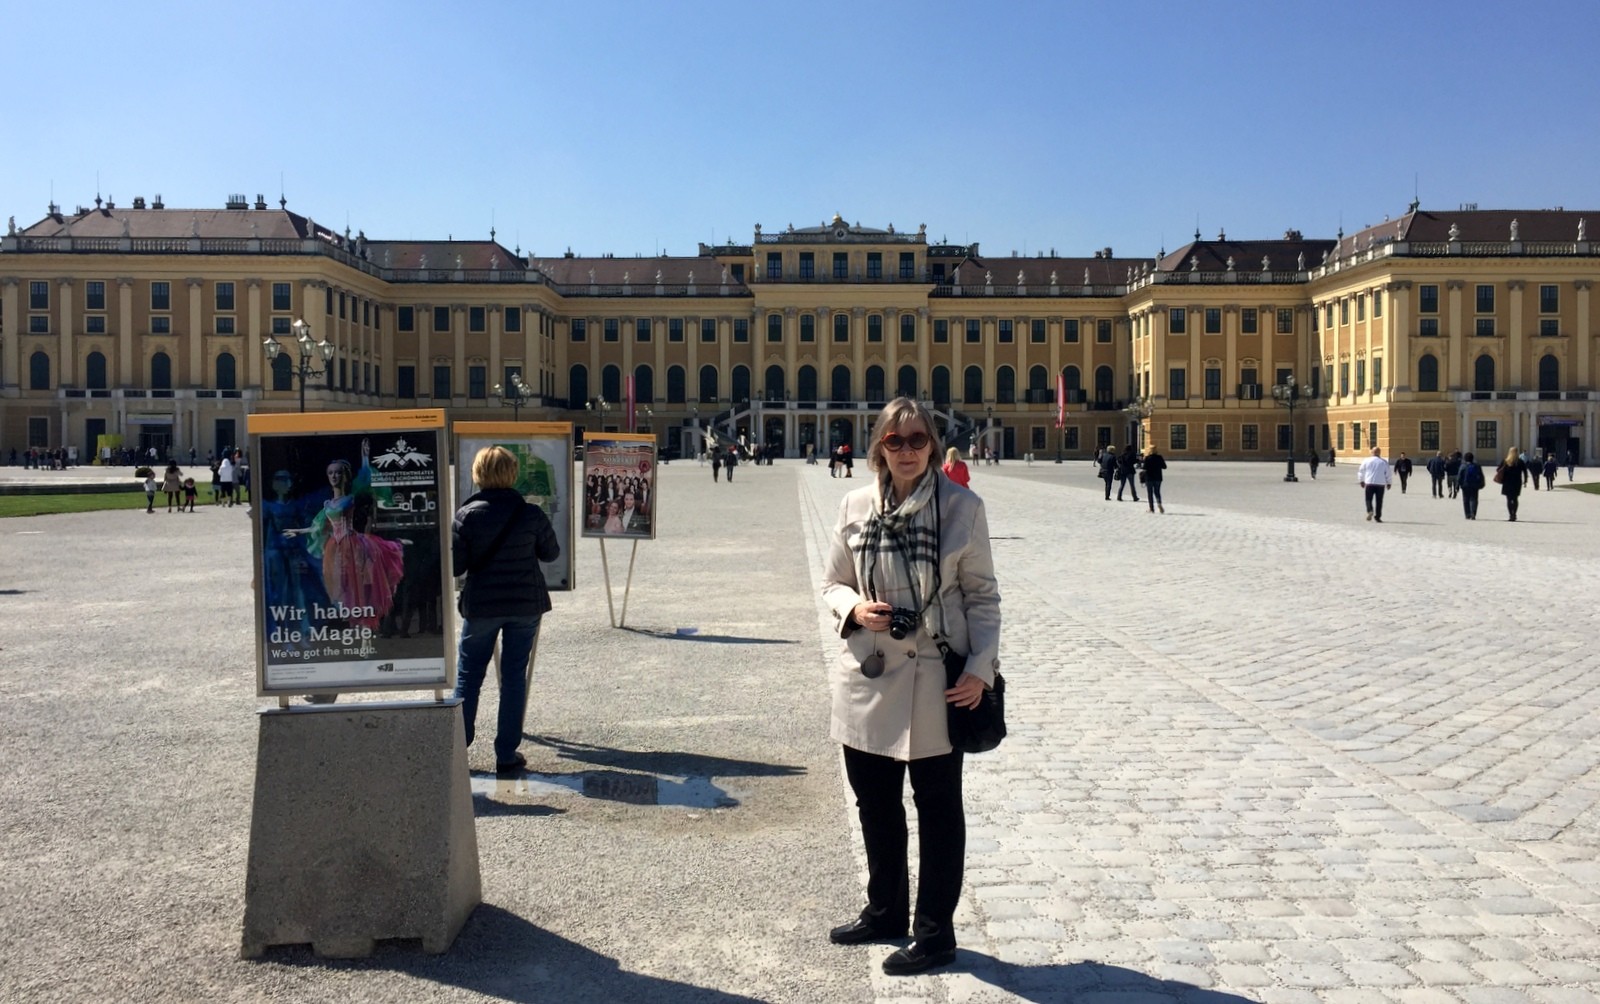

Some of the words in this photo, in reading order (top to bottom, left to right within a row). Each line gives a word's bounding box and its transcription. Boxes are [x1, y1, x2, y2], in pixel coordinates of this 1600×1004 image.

[270, 606, 305, 621] Wir
[314, 603, 375, 618] haben
[270, 628, 301, 643] die
[309, 625, 377, 645] Magie.
[271, 649, 300, 658] We've
[303, 649, 320, 660] got
[323, 646, 340, 656] the
[343, 646, 378, 657] magic.
